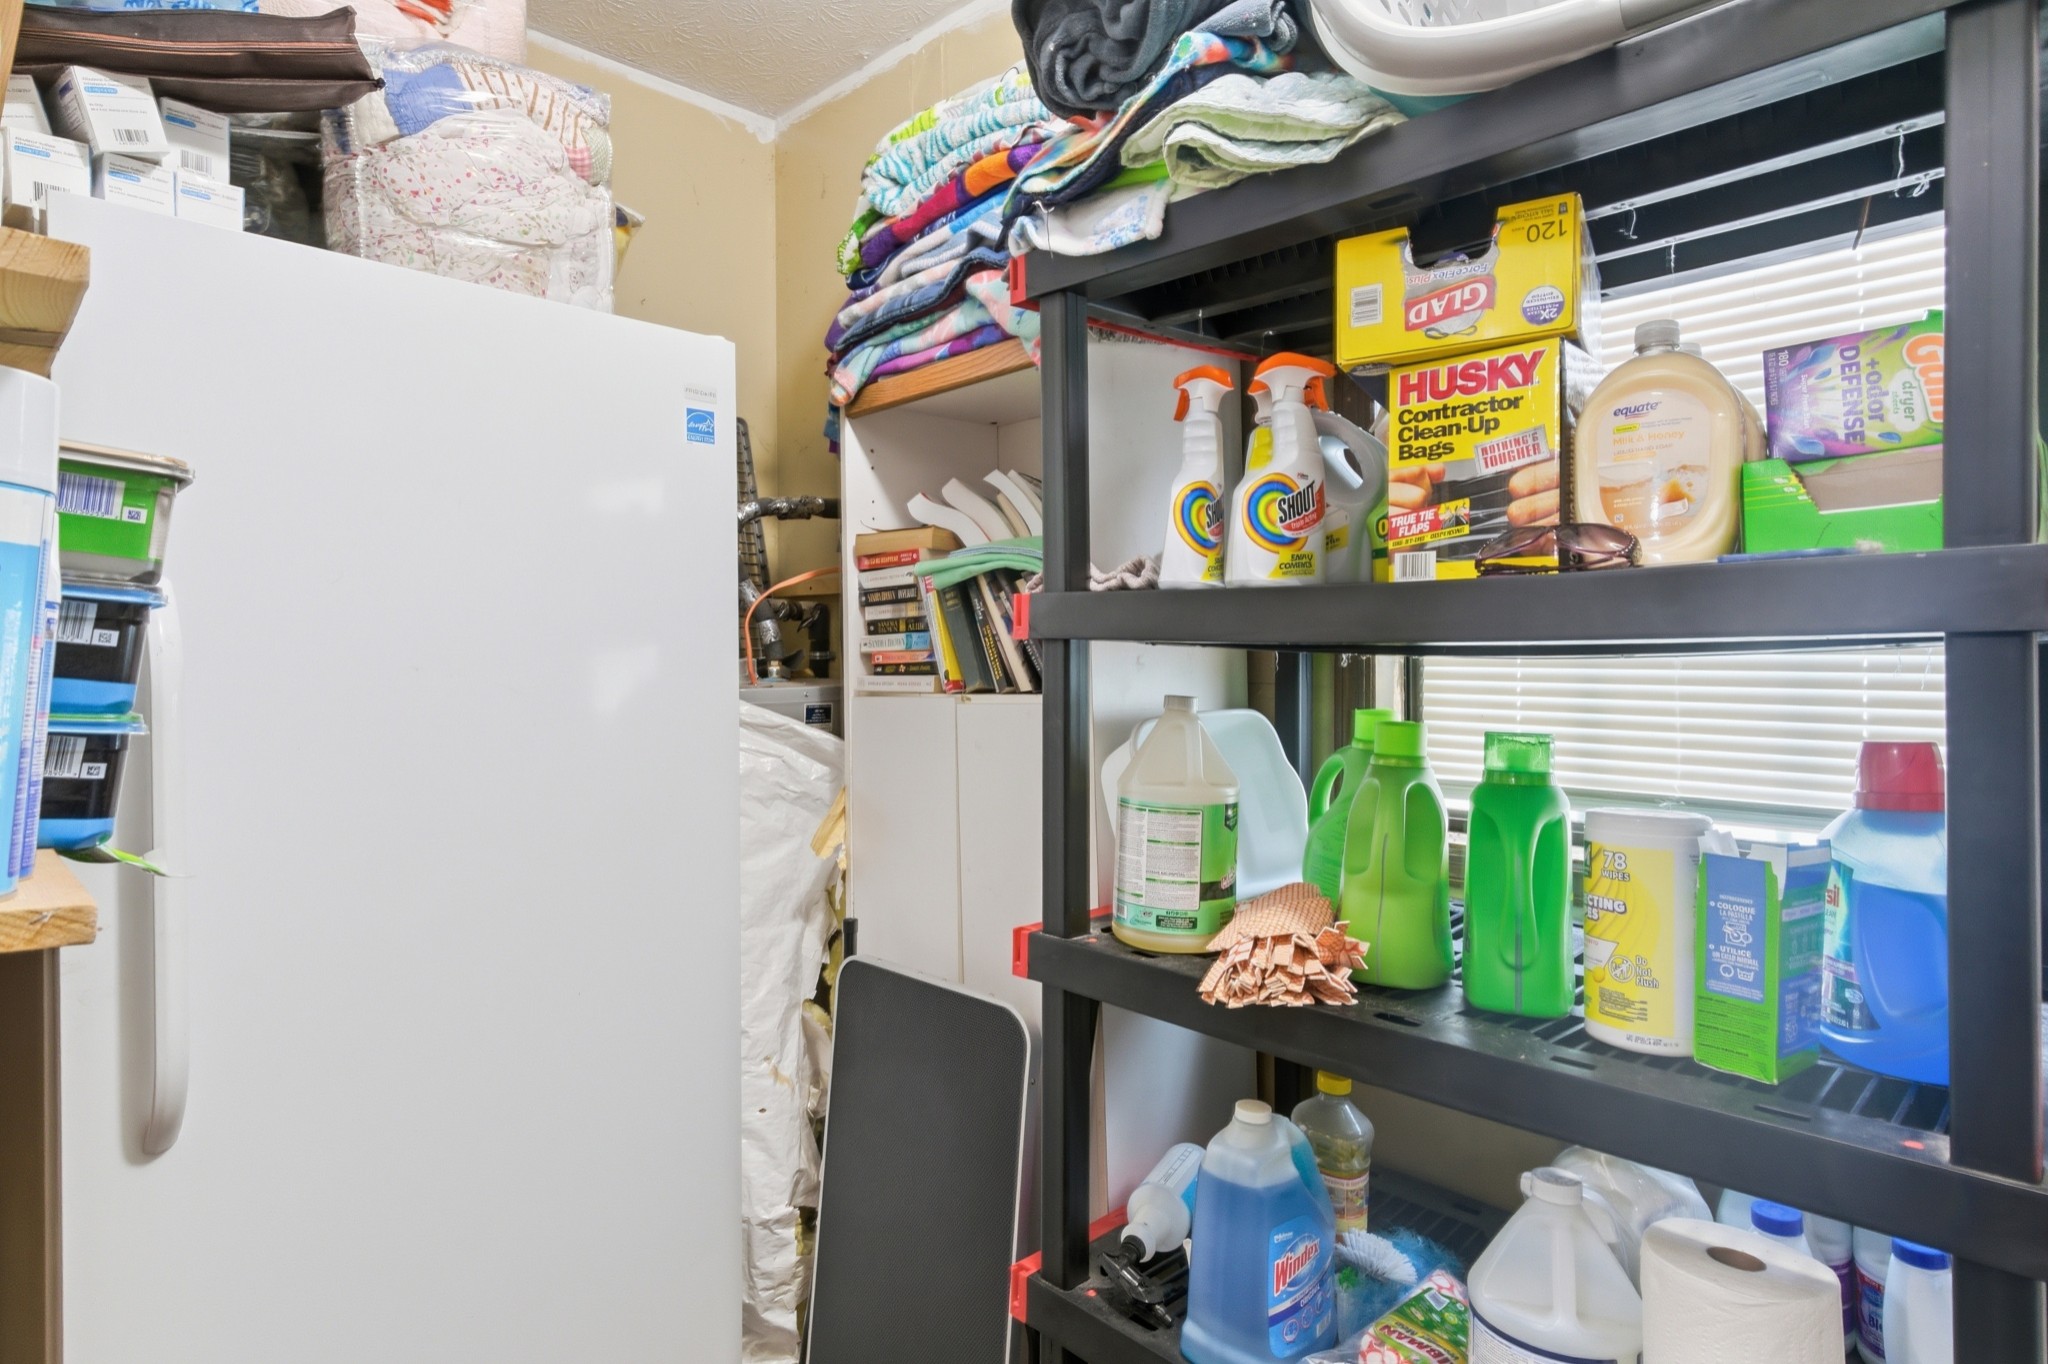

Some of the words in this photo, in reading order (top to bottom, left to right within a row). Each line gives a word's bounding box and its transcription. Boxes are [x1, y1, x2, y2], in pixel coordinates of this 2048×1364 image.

[1527, 219, 1567, 242] 120
[1409, 282, 1488, 323] GLAD
[1778, 350, 1789, 367] 180
[1399, 349, 1546, 406] HUSKY
[1839, 345, 1865, 444] DEFENSE
[1900, 380, 1918, 422] dryer
[1398, 396, 1524, 425] Contractor
[1613, 401, 1658, 419] equate
[1398, 416, 1500, 442] Clean-Up
[1613, 435, 1634, 446] Milk
[1648, 431, 1685, 442] Honey
[1398, 441, 1455, 461] Bags
[1481, 431, 1539, 457] NOTHING'S
[1483, 442, 1542, 469] TOUGHER
[1278, 479, 1315, 523] SHOUT
[1391, 514, 1418, 528] TRUE
[1419, 509, 1437, 522] TIE
[1399, 521, 1430, 537] FLAPS
[1603, 851, 1627, 870] 78
[1602, 869, 1630, 882] WIPES
[1826, 884, 1840, 908] sil
[1717, 902, 1756, 915] COLOQUE
[1635, 955, 1647, 966] Do
[1720, 945, 1752, 958] UTILICE
[1635, 967, 1652, 977] Not
[1635, 977, 1659, 989] Flush
[1273, 1238, 1320, 1297] Windex
